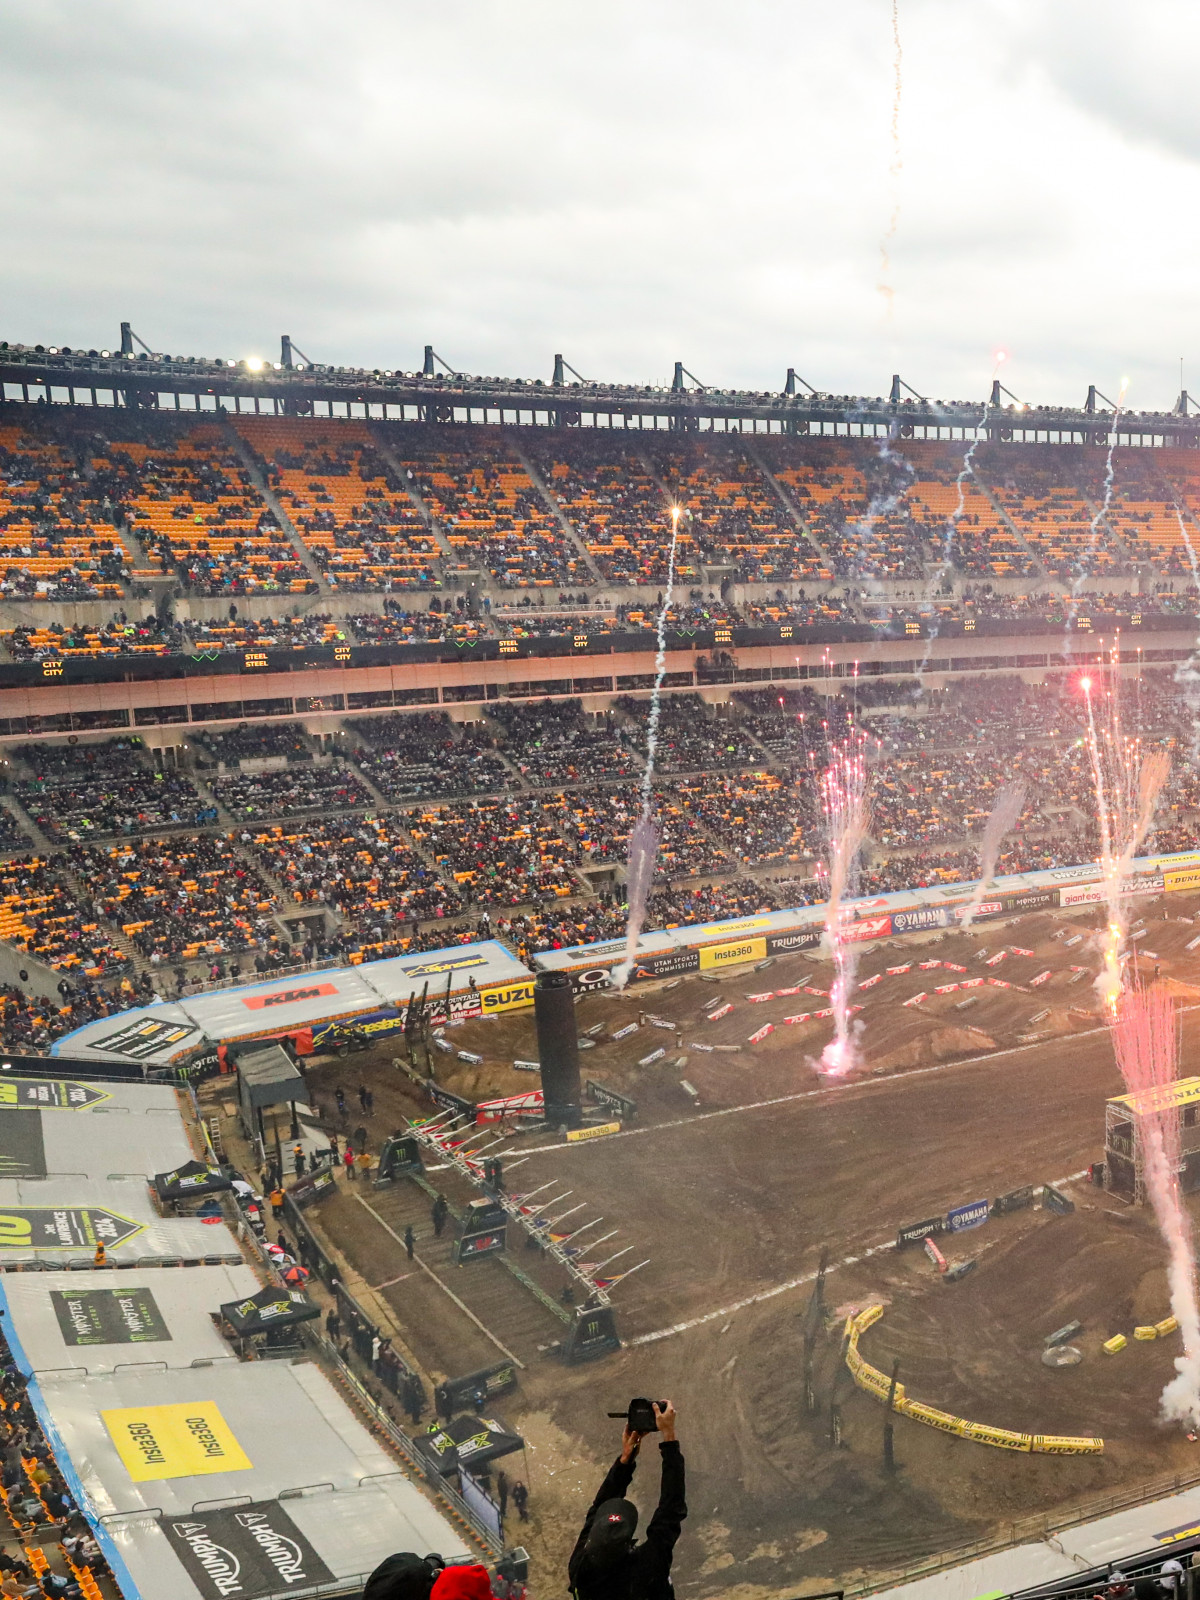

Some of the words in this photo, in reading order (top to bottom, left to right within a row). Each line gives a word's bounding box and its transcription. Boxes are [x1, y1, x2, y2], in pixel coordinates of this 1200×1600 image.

[1016, 895, 1050, 906] MONSTER
[1065, 895, 1085, 905] giant
[906, 908, 946, 923] YAMAHA
[771, 935, 813, 948] TRIUMPH
[673, 954, 698, 964] SPORTS
[714, 945, 752, 960] Insta360
[655, 961, 698, 973] COMMISSION
[573, 981, 610, 994] OAKLE
[264, 988, 320, 1007] KTM
[484, 987, 536, 1007] SUZU
[578, 1126, 610, 1138] Insta360
[960, 1205, 988, 1222] YAMAHA
[53, 1211, 74, 1245] LAWRENCE
[94, 1218, 118, 1238] 2024
[903, 1225, 934, 1239] TRIUMPH
[68, 1300, 92, 1335] MONSTER
[119, 1298, 144, 1332] MONSTER
[864, 1372, 898, 1394] DUNL
[912, 1411, 958, 1432] DUNLOP
[127, 1422, 166, 1465] Insta360
[185, 1417, 225, 1458] Insta360
[974, 1432, 1027, 1449] DUNLOP
[248, 1523, 307, 1584] TRIUMPH
[186, 1533, 243, 1597] TRIUMPH
